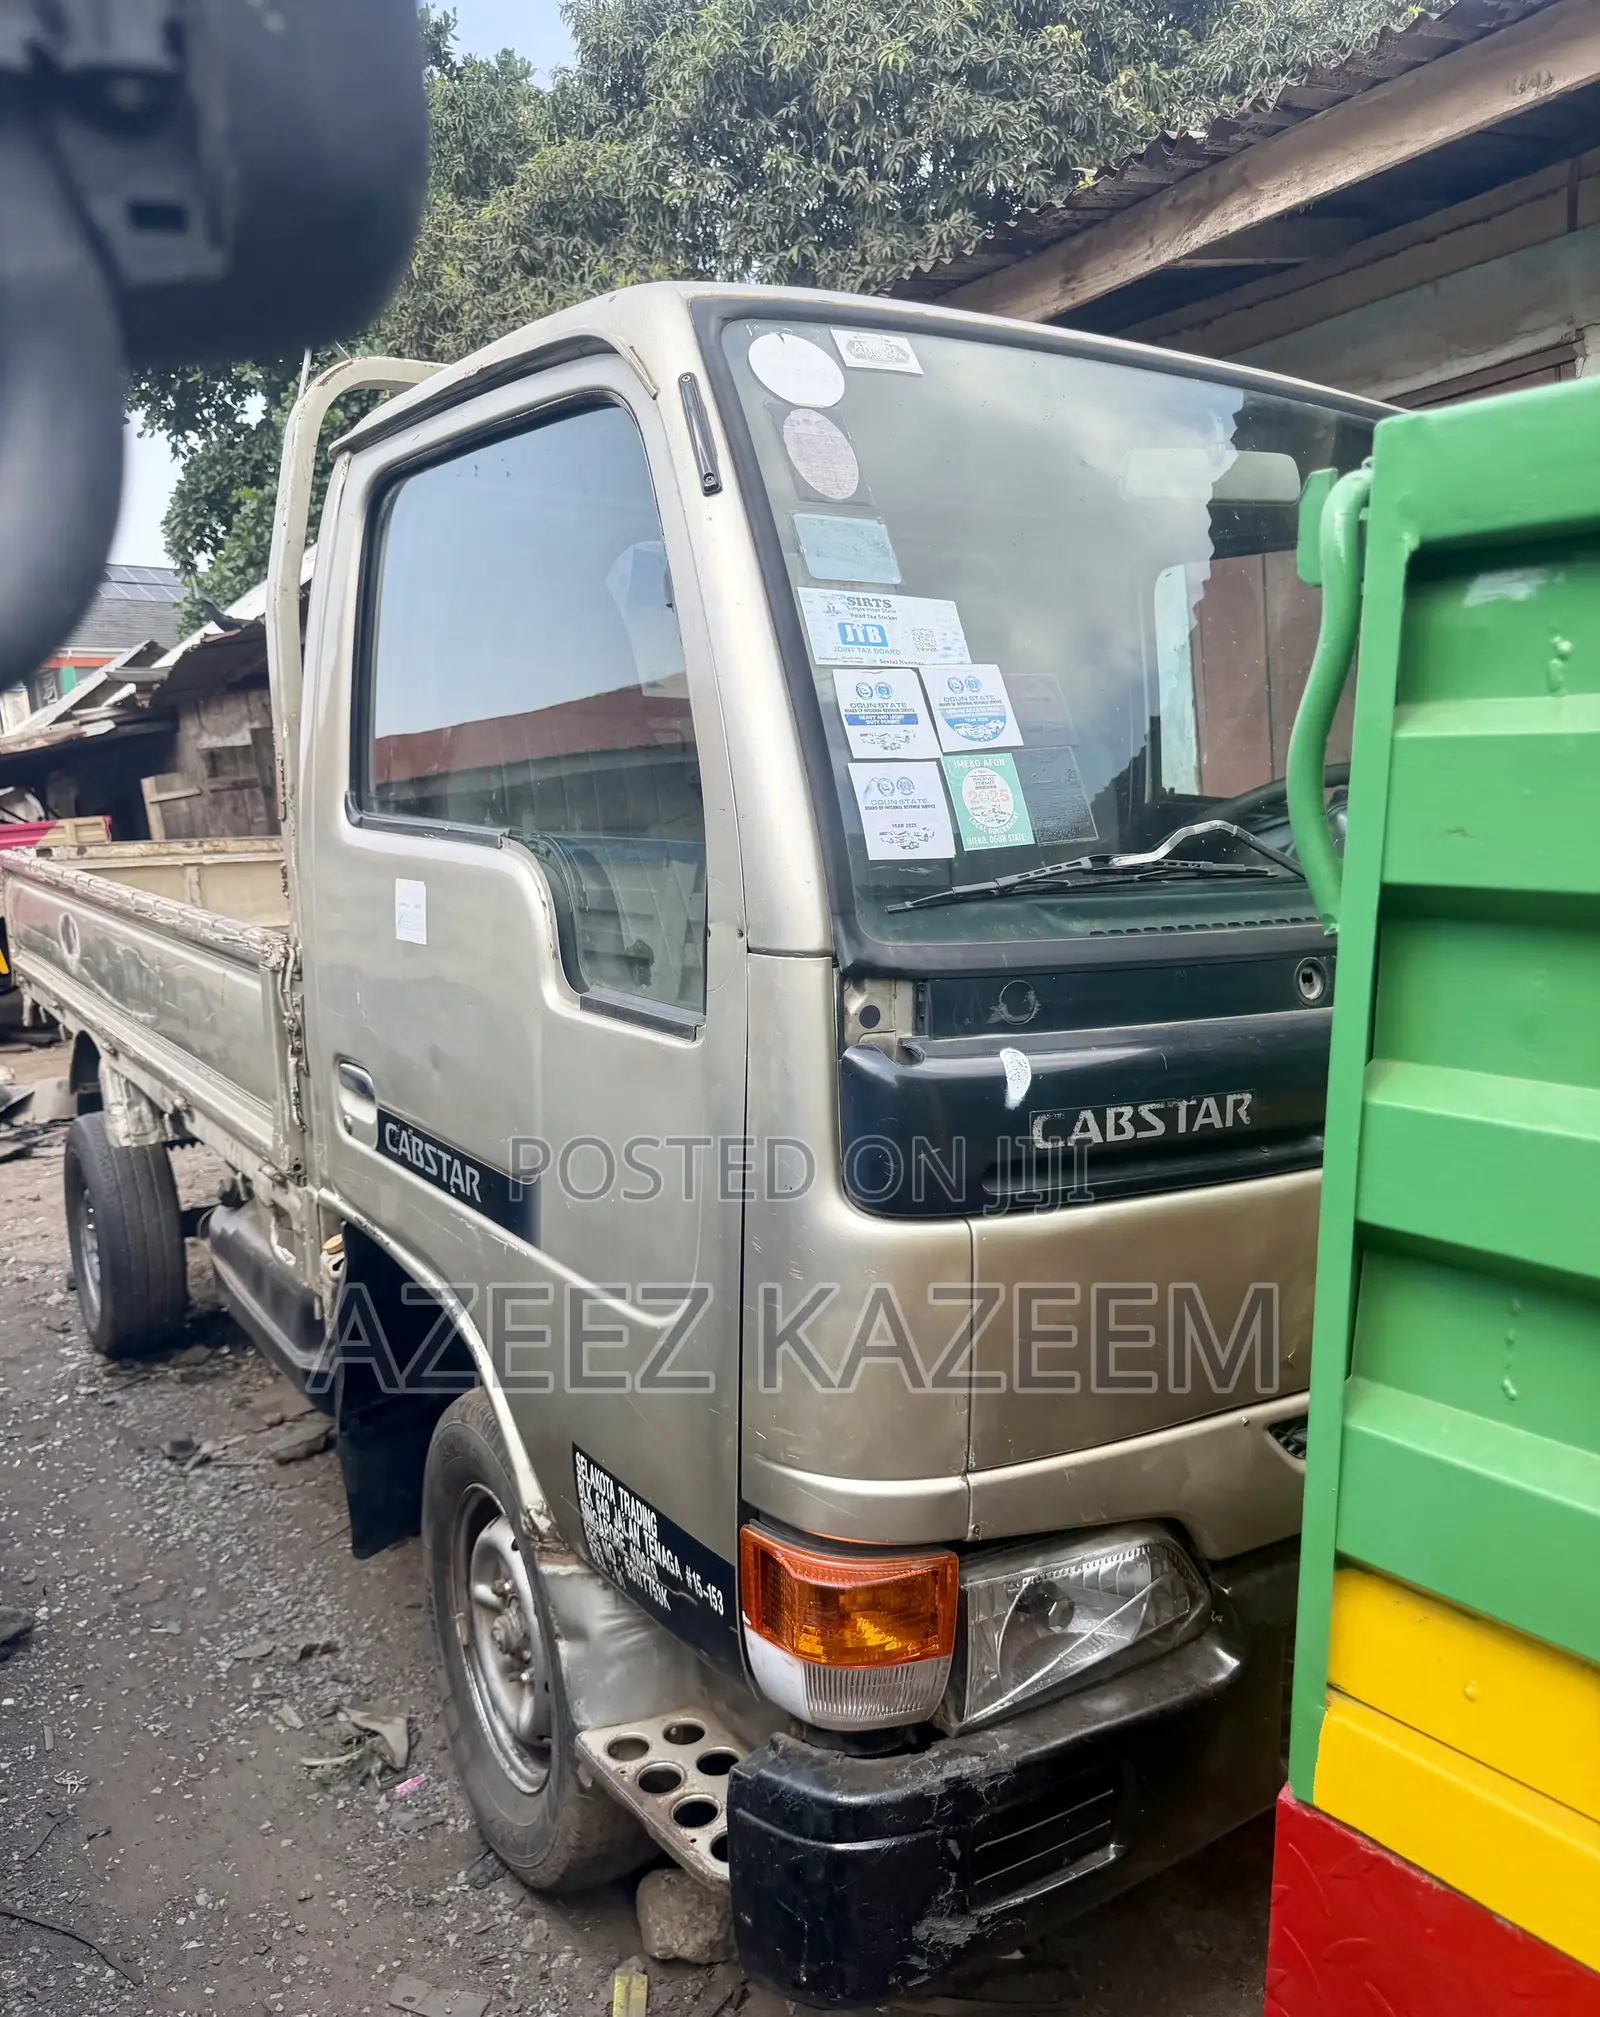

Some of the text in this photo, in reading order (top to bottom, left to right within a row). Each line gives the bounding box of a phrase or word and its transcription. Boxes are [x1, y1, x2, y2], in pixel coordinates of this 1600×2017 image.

[846, 596, 892, 608] SIRTS
[844, 625, 882, 643] JTB
[953, 758, 1005, 768] IMEKO AFON
[968, 789, 1010, 804] 2025
[968, 816, 987, 832] LOCAL
[988, 811, 1020, 835] GOVERNMENT
[989, 834, 1007, 844] OGUN
[1008, 833, 1026, 842] STATE
[1031, 1092, 1253, 1150] CABSTAR
[385, 1122, 482, 1203] CABSTAR
[575, 1451, 658, 1539] SELAKOTA TRADING
[580, 1499, 628, 1556] SINGAPORE
[577, 1474, 594, 1508] BLK
[613, 1506, 641, 1549] JALAN
[643, 1529, 683, 1581] TENAGA
[685, 1564, 724, 1617] #15-153
